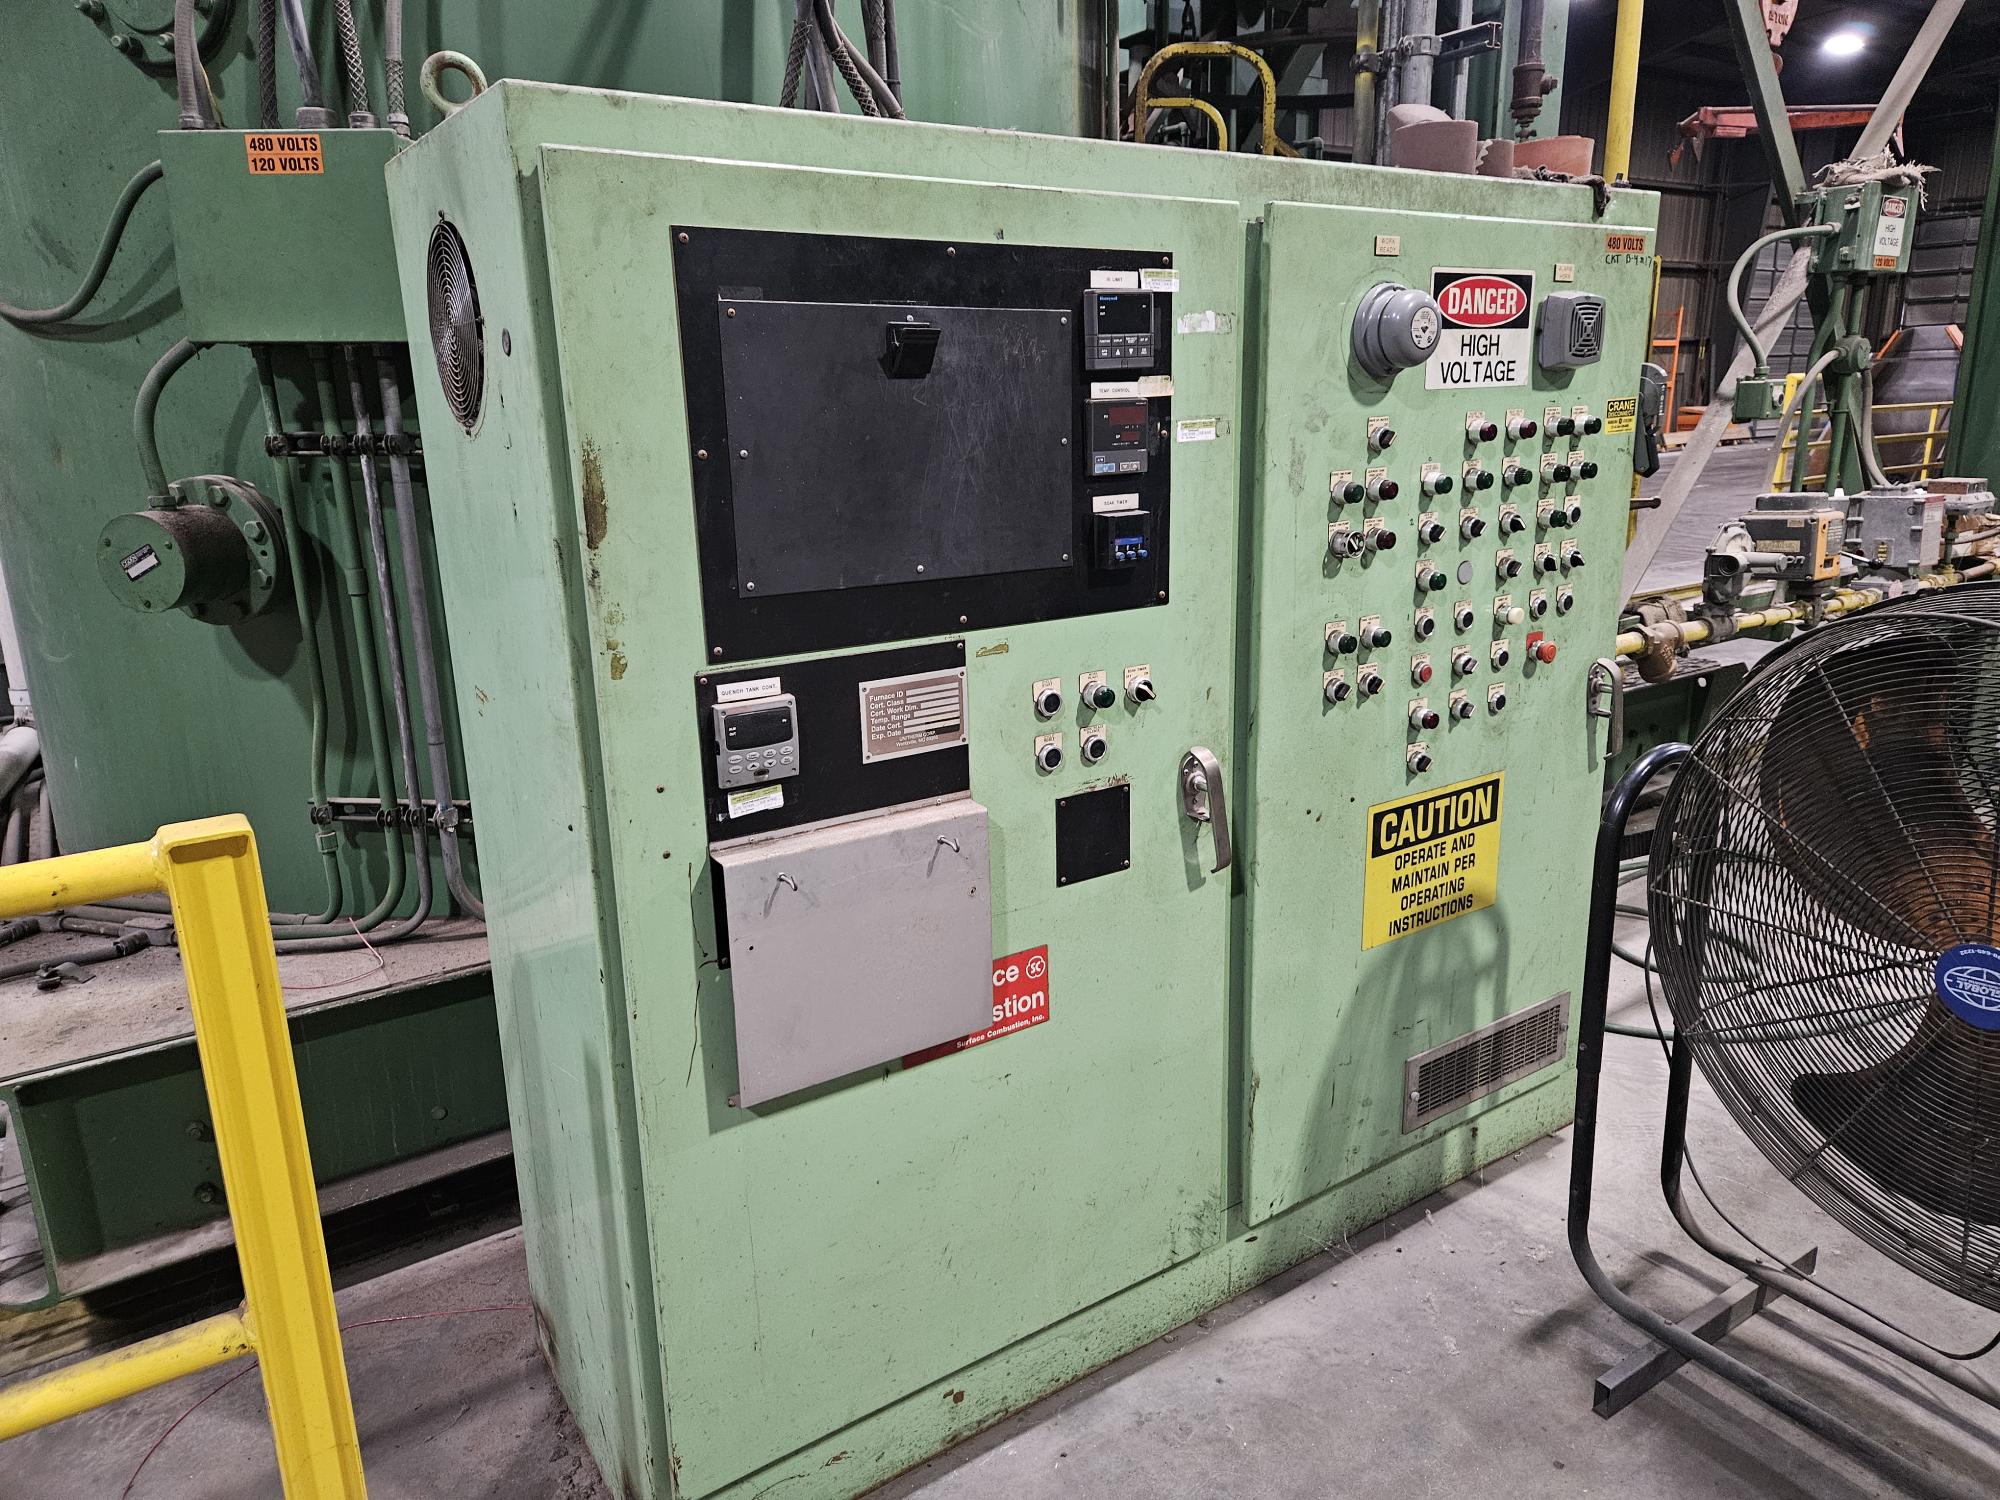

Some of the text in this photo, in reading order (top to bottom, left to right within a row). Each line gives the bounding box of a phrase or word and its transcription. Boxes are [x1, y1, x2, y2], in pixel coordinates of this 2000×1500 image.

[249, 137, 318, 151] 480 VOLTS
[251, 157, 320, 172] 120 VOLTS
[1885, 224, 1896, 233] HIGH
[1607, 237, 1644, 251] 480 VOLTS
[1879, 236, 1899, 247] VOLTAGE
[1447, 287, 1518, 315] DANGER
[1460, 334, 1500, 357] HIGH
[1440, 360, 1516, 384] VOLTAGE
[1608, 400, 1635, 412] CRANE
[869, 690, 904, 702] Furnace ID
[869, 699, 904, 710] Cert. Class
[870, 710, 886, 718] Cert.
[887, 707, 903, 715] Work
[870, 713, 911, 726] Temp. Range
[871, 722, 901, 733] Date Cert.
[871, 730, 901, 741] Exp. Date
[1380, 785, 1493, 850] CAUTION
[1394, 832, 1475, 871] OPERATE AND
[1392, 853, 1476, 894] MAINTAIN PER
[1401, 876, 1465, 911] OPERATING
[1389, 893, 1473, 936] INSTRUCTIONS
[1030, 960, 1041, 974] SC
[956, 1014, 1045, 1048] Surface Combustion, Inc.
